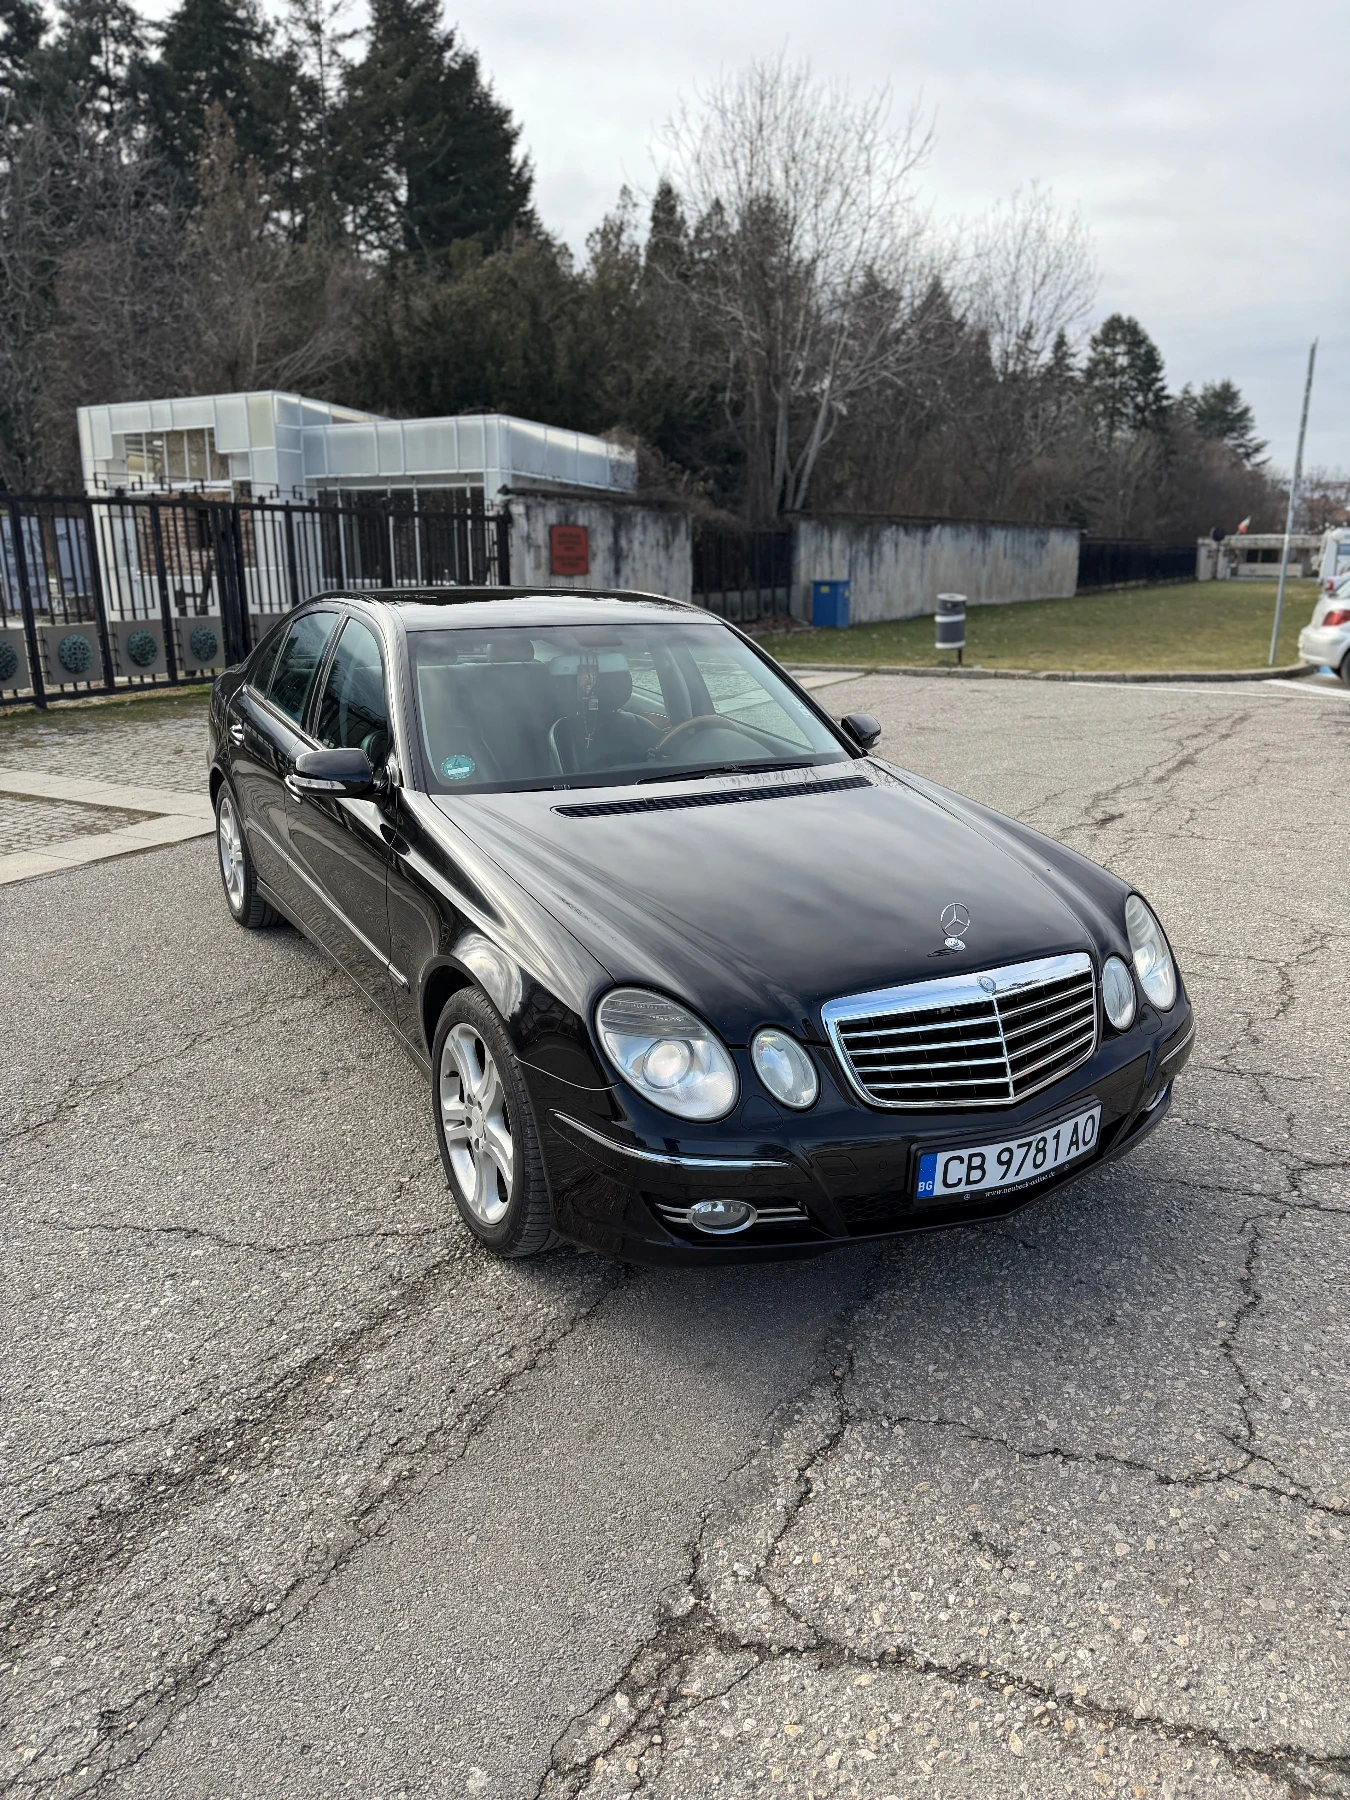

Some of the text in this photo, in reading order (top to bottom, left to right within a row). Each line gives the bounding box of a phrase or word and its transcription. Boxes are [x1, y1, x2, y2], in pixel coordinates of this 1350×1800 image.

[942, 1114, 1096, 1189] CB 9781 AO
[917, 1180, 933, 1192] BG
